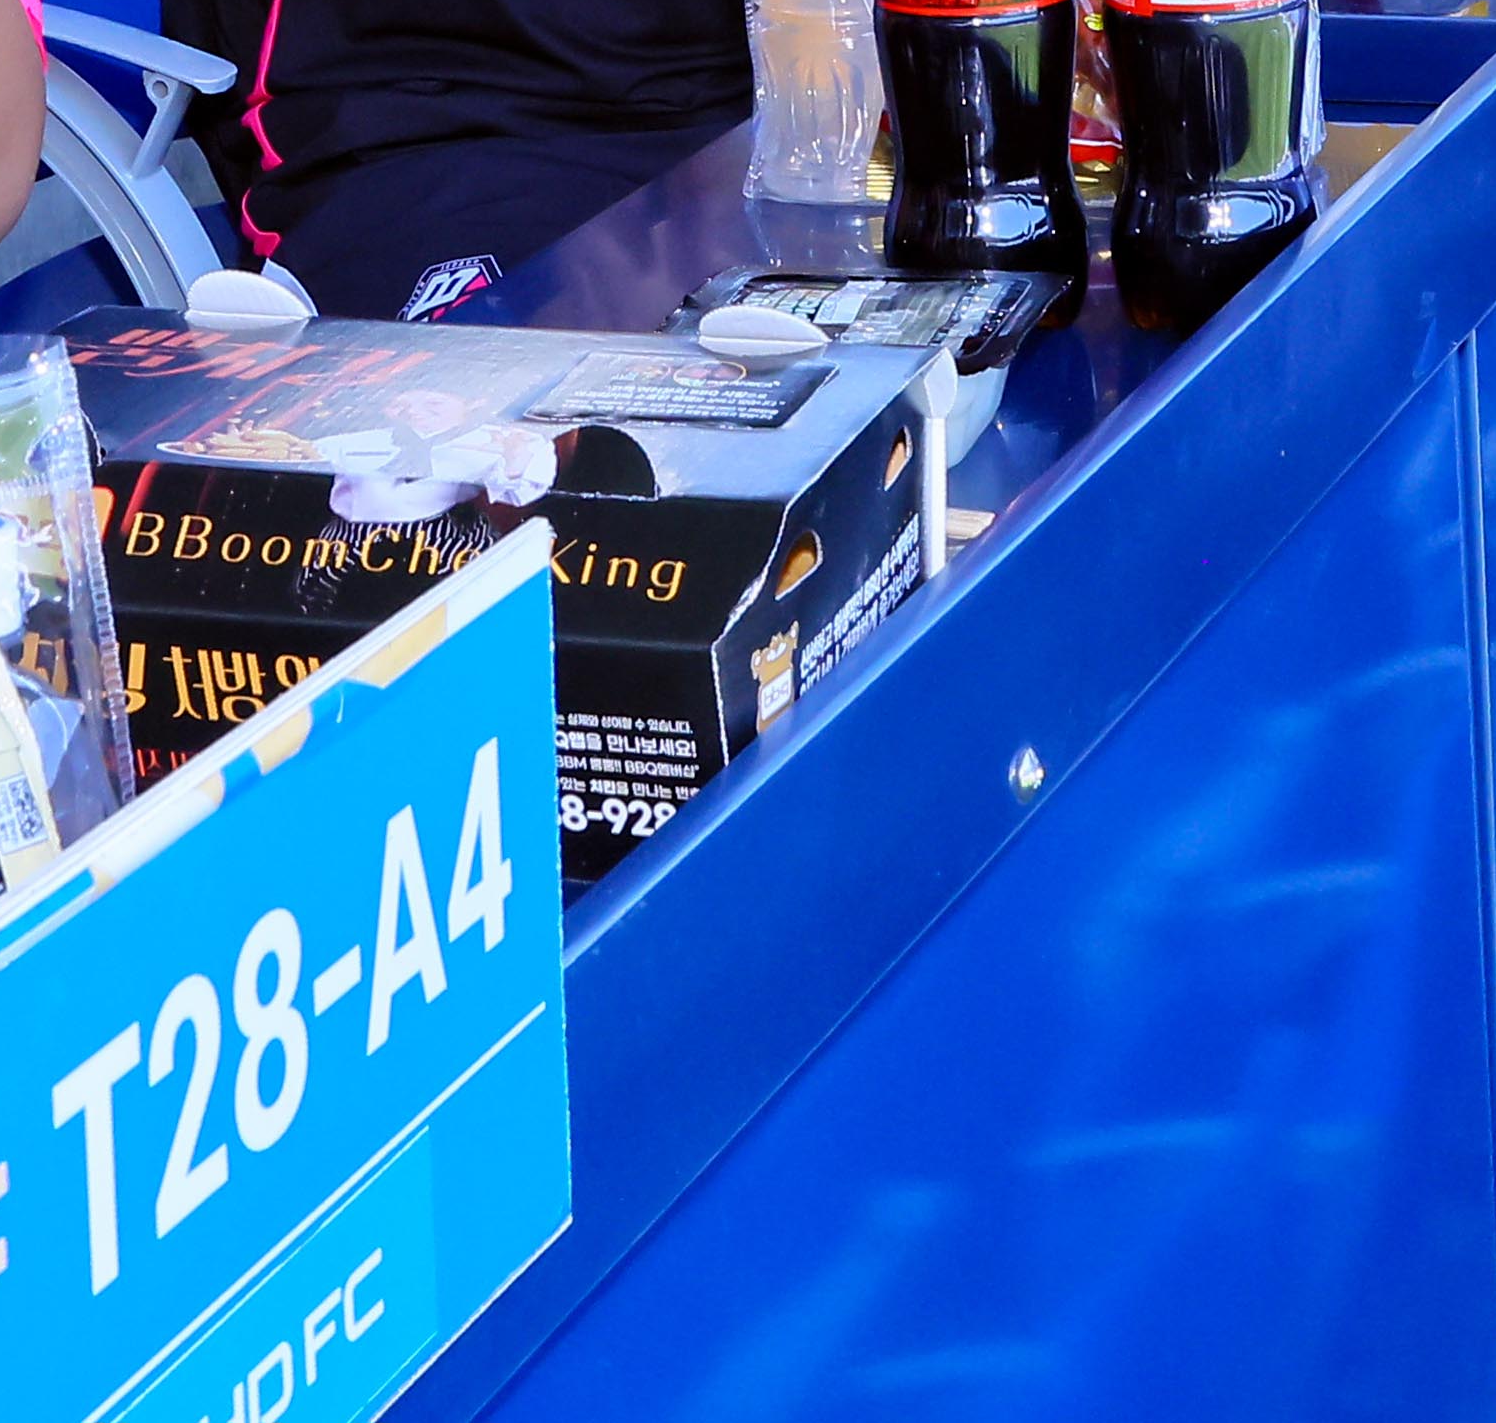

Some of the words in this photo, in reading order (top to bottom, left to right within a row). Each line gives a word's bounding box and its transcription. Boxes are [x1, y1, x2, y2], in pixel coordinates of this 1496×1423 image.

[634, 718, 644, 732] 수
[647, 718, 694, 734] 있습니다.
[606, 735, 697, 758] 만나보세요!
[590, 779, 629, 796] 치킨을
[632, 782, 672, 799] 만나는
[50, 737, 513, 1295] T28-A4
[306, 1247, 386, 1387] FC
